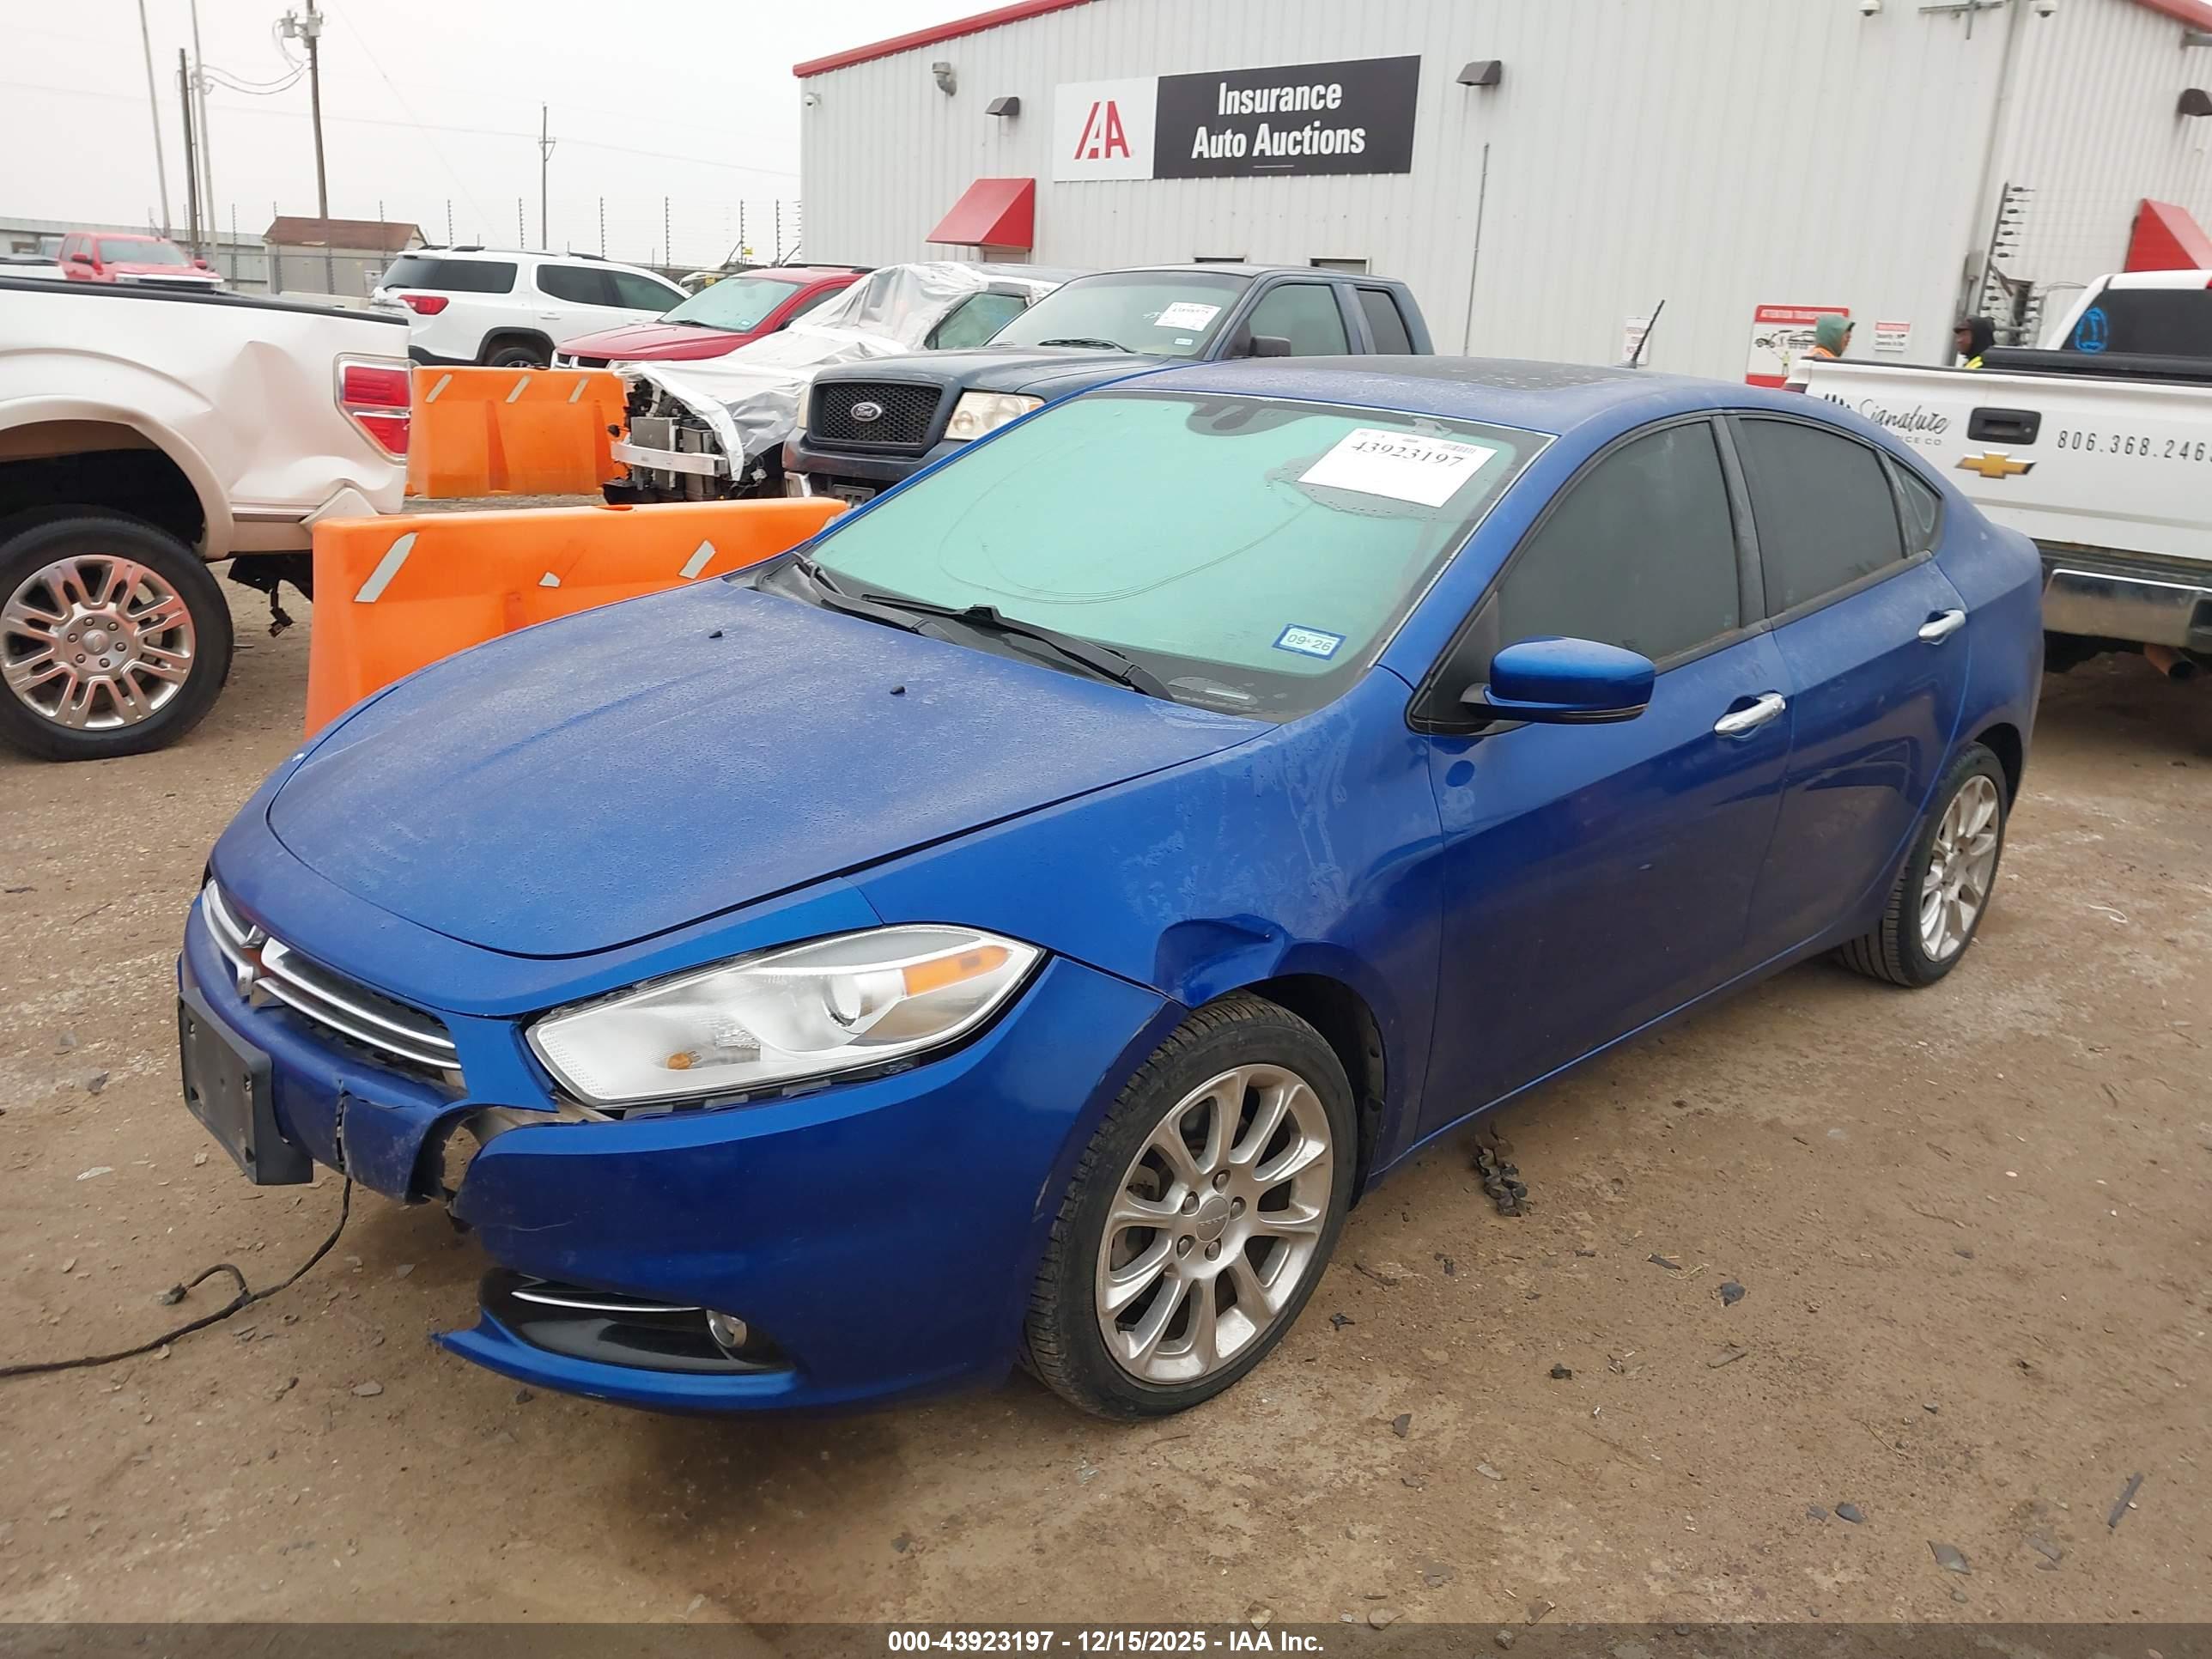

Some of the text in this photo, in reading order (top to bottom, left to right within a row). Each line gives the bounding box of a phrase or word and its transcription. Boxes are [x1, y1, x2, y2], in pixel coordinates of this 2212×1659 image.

[1218, 82, 1342, 116] Insurance
[1191, 120, 1366, 159] Auto Auctions
[1352, 441, 1465, 467] 43923197
[2057, 430, 2212, 463] 806.368.246
